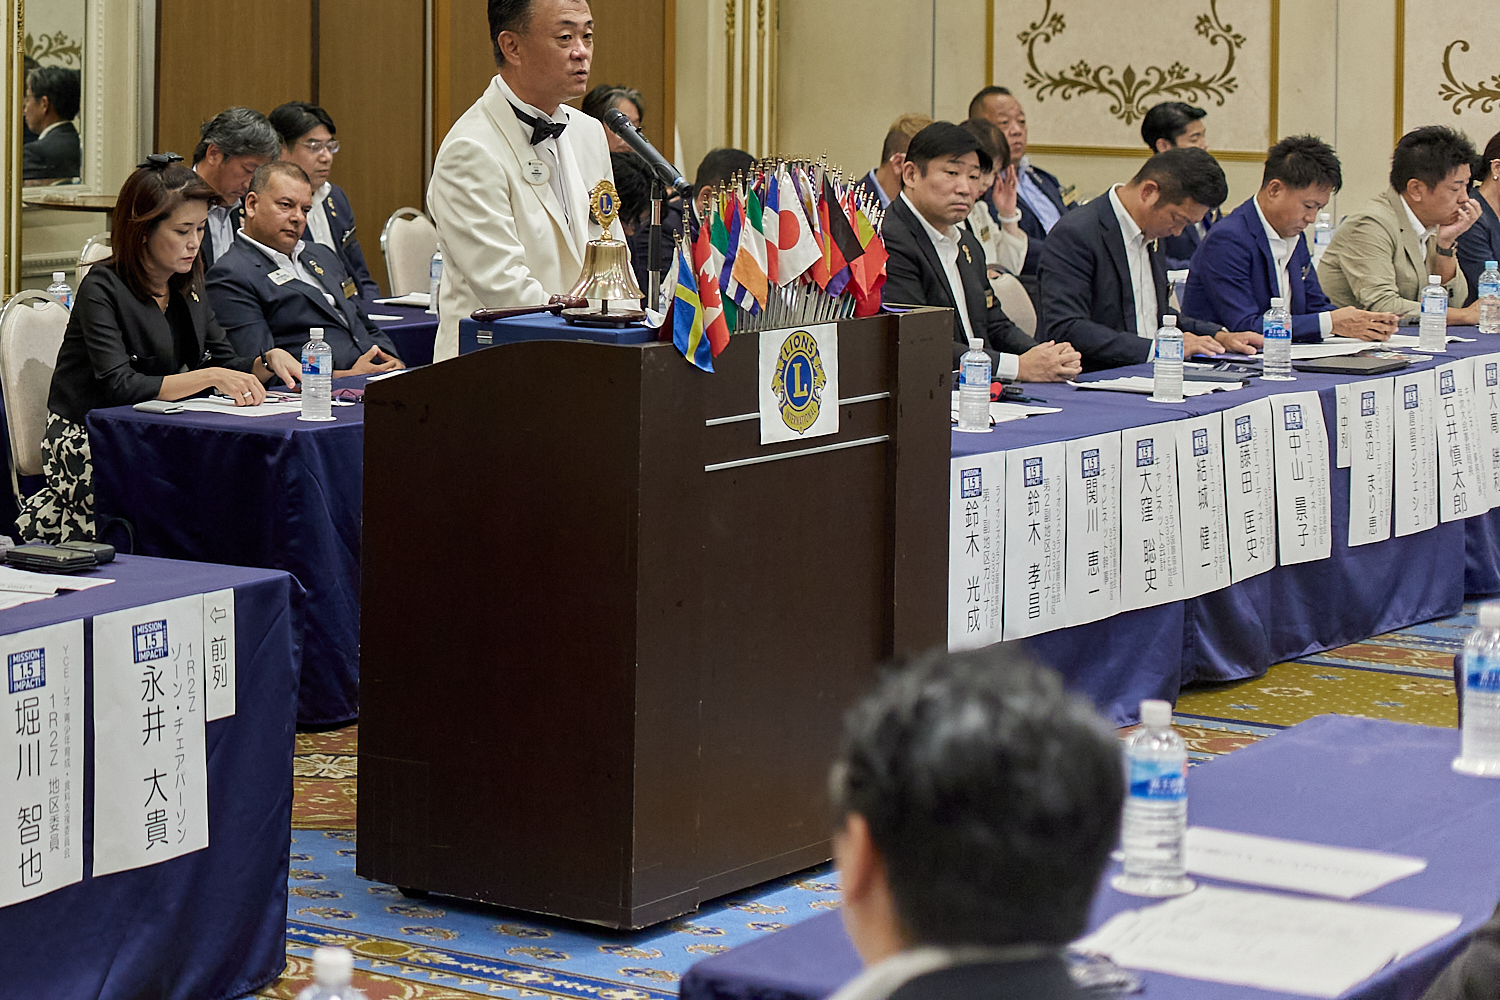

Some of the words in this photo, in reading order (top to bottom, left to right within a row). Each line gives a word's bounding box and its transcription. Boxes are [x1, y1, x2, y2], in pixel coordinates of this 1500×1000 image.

[783, 335, 815, 357] LIONS
[793, 363, 808, 397] L
[785, 406, 817, 425] INTERNATIONAL
[1289, 431, 1304, 480] 中山
[965, 501, 979, 557] 鈴木
[1028, 490, 1041, 545] 鈴木
[137, 620, 163, 635] MISSION
[967, 576, 980, 633] 光成
[13, 649, 40, 664] MISSION
[144, 633, 157, 649] 1.5
[211, 635, 228, 690] 前列
[20, 662, 34, 678] 1.5
[186, 642, 196, 712] 1R2Z
[49, 693, 58, 767] 1R2Z
[141, 665, 165, 745] 永井
[15, 696, 41, 781] 堀川
[144, 768, 168, 850] 大貴
[17, 804, 43, 888] 智也
